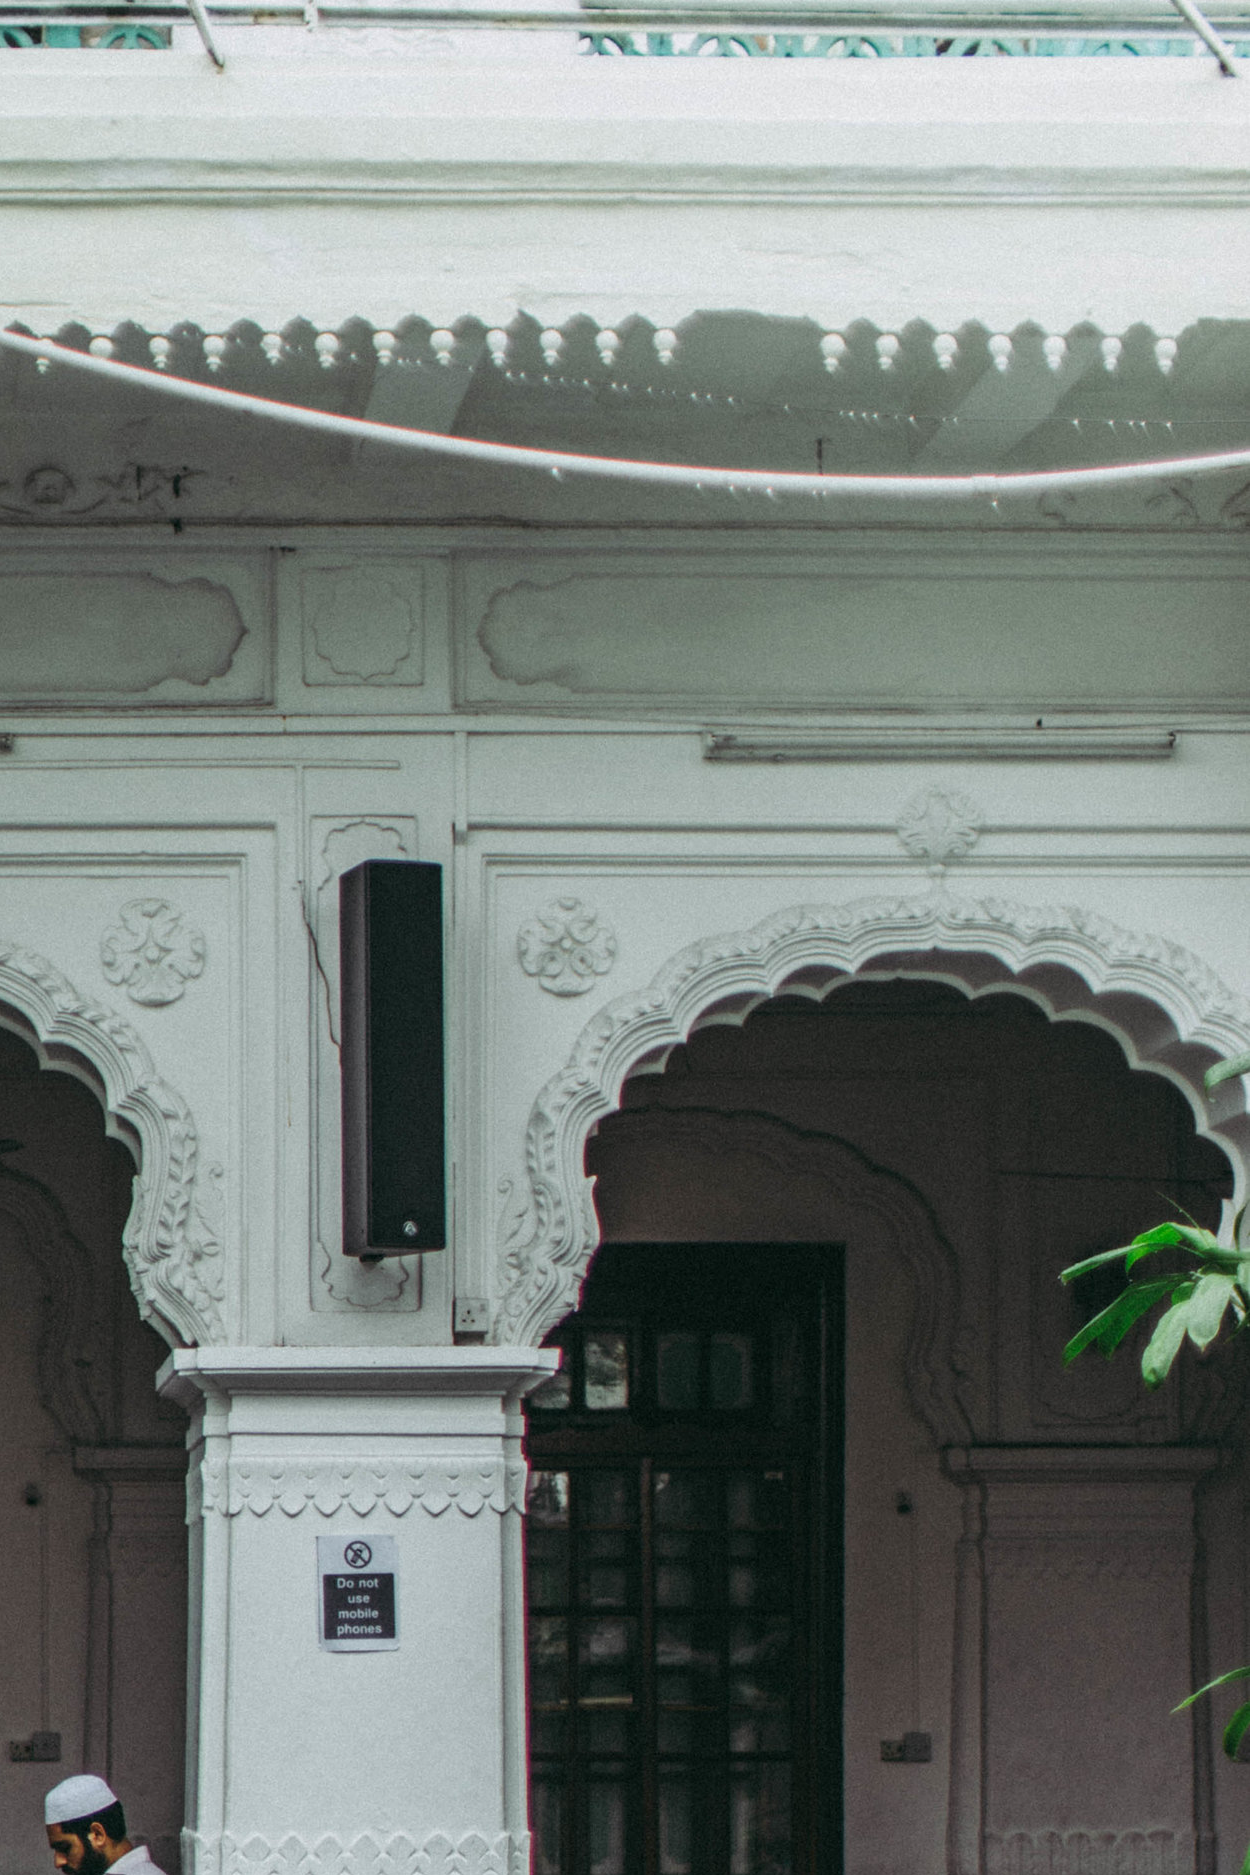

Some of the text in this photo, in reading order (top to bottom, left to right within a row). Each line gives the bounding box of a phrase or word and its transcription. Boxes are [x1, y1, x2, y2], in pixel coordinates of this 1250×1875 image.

[337, 1578, 379, 1589] Do not
[347, 1594, 370, 1604] use
[338, 1608, 379, 1619] mobile
[337, 1624, 383, 1637] phones
